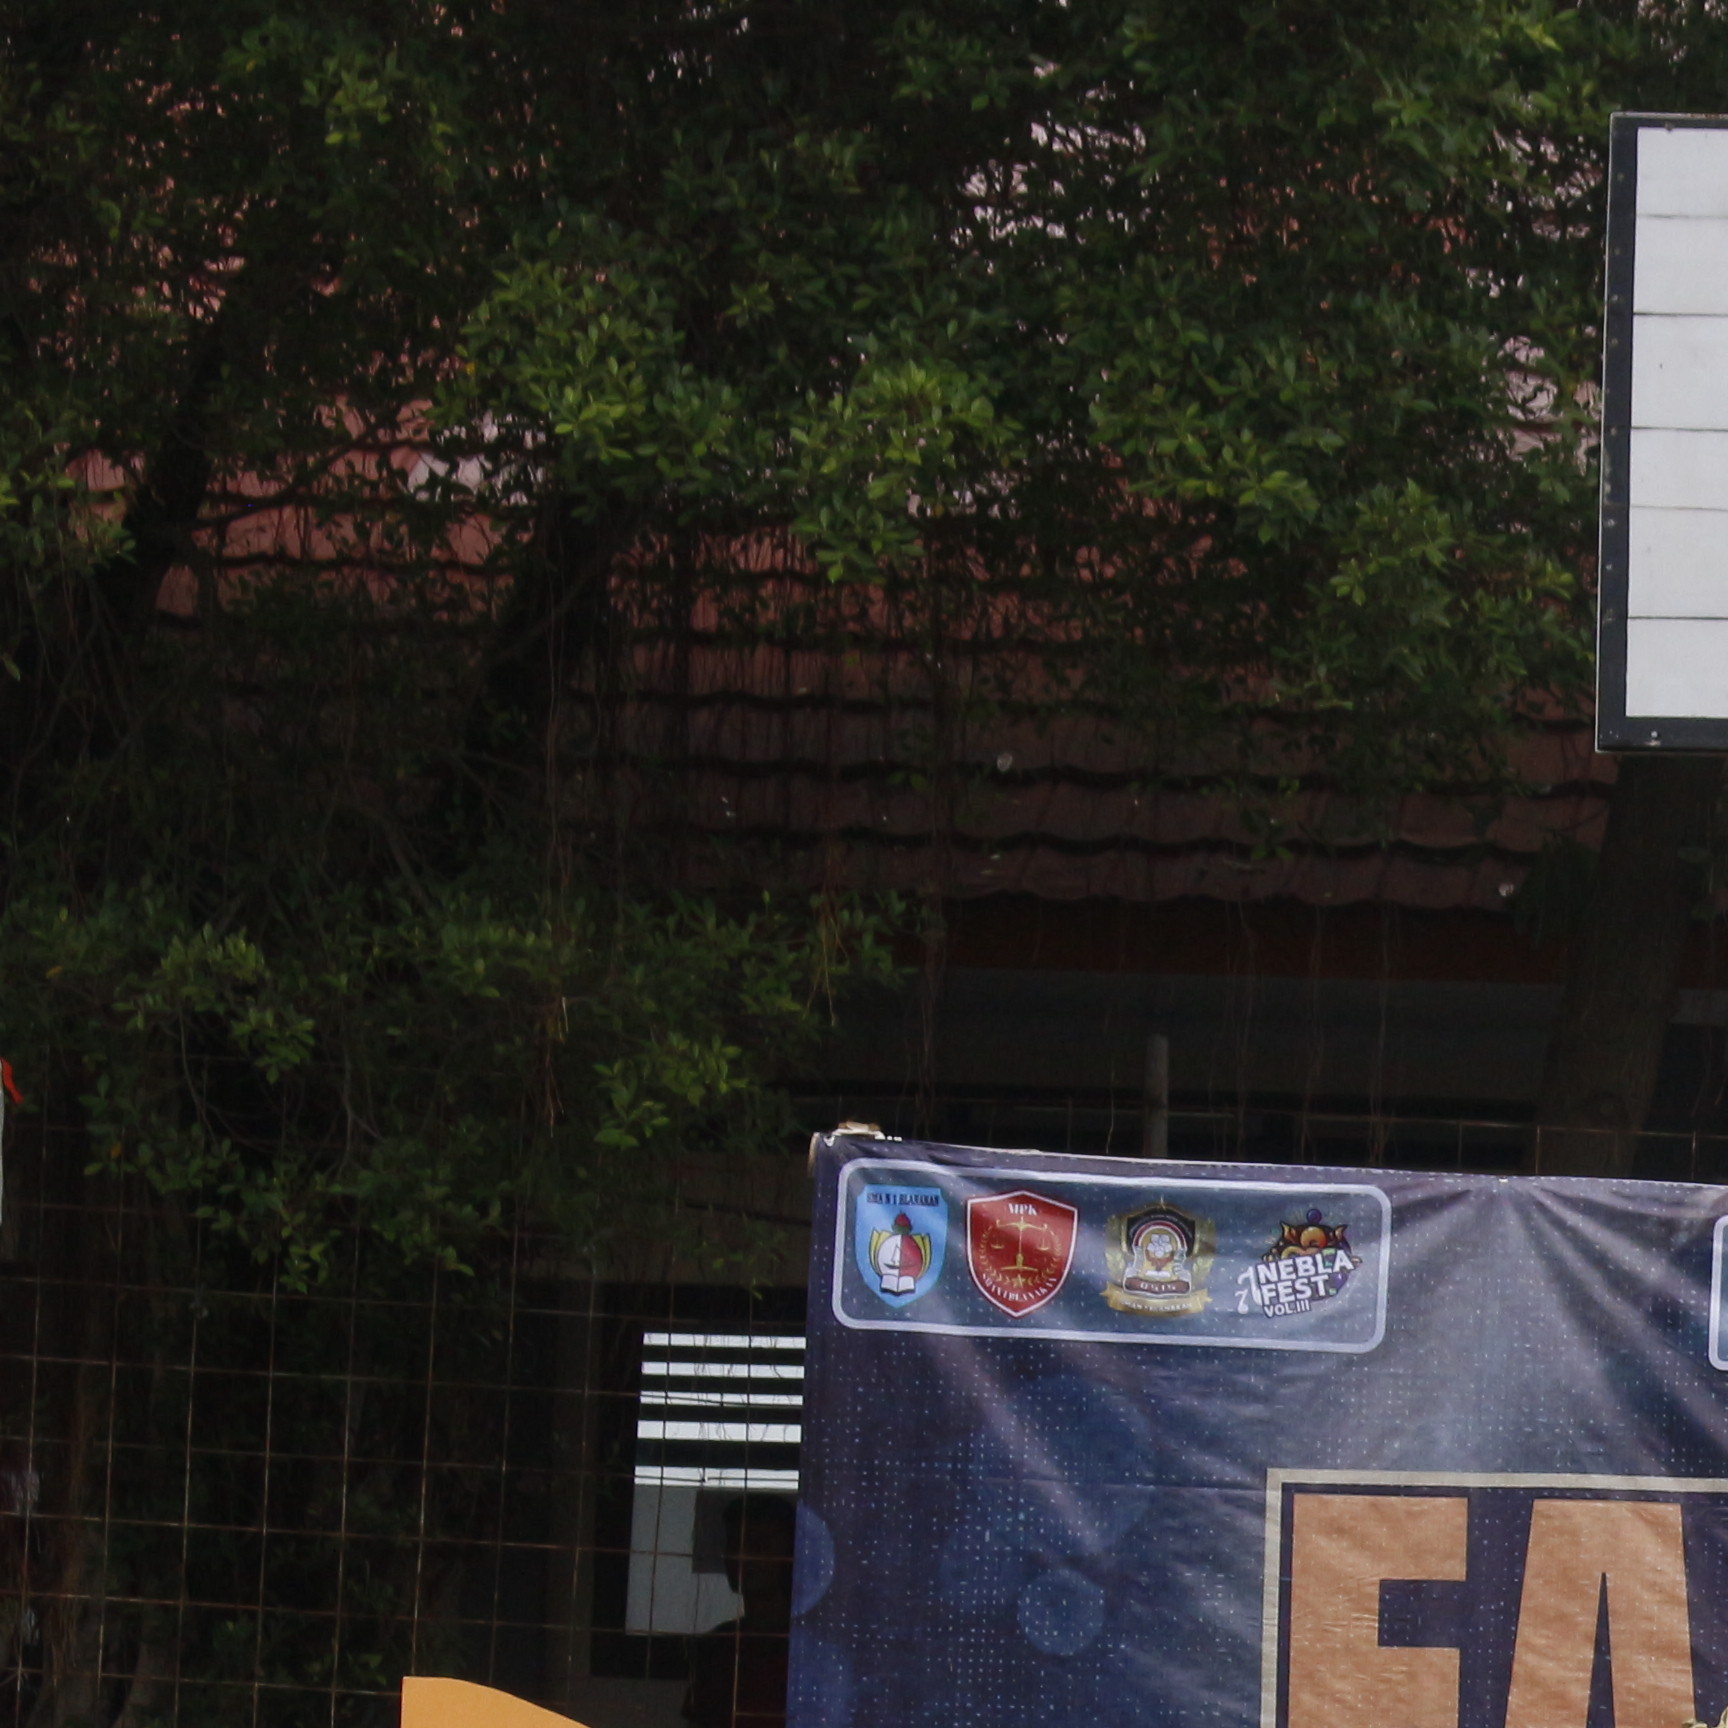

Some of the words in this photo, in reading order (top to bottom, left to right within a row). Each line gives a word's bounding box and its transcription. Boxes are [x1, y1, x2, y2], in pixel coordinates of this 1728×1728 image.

[1008, 1203, 1038, 1216] MPK
[1257, 1248, 1355, 1284] NEBLA
[1261, 1274, 1329, 1306] FEST
